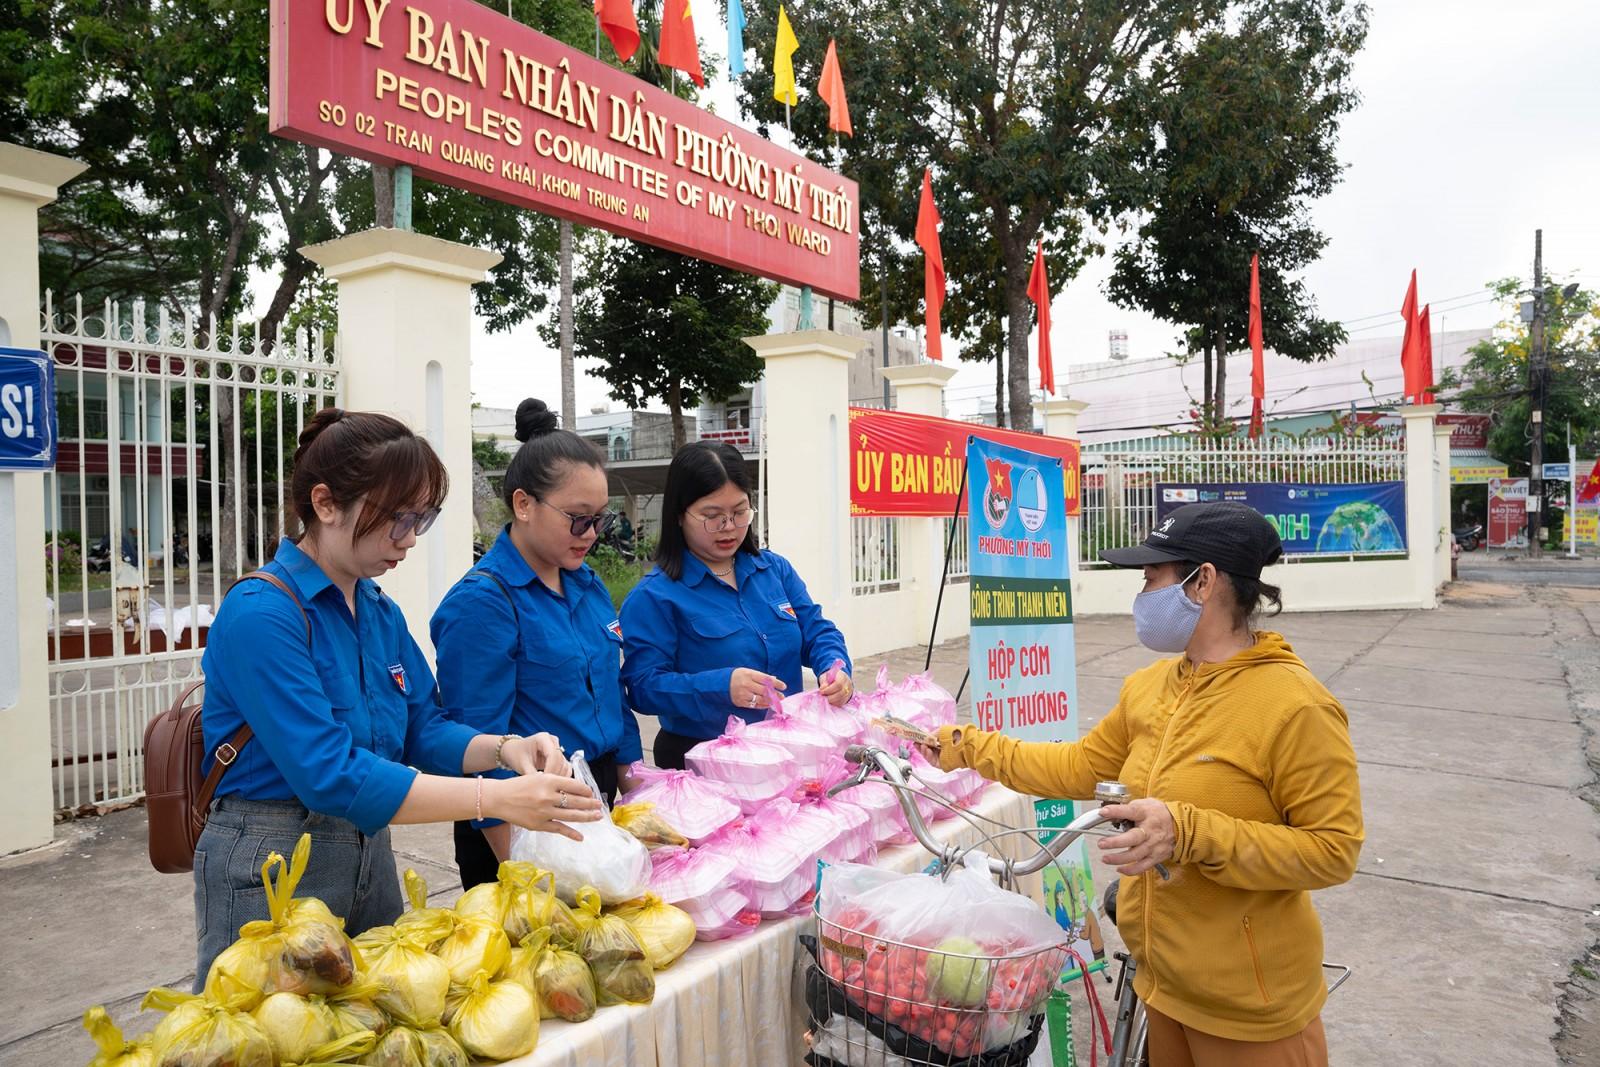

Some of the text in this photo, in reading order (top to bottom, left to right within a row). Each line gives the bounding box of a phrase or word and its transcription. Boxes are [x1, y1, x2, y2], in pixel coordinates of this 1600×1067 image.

[405, 6, 490, 88] BAN
[502, 48, 600, 132] NHÂN
[608, 90, 668, 159] DÂN
[674, 131, 769, 200] PHƯỜNG
[809, 185, 853, 234] THỚI
[319, 100, 347, 127] SO
[355, 111, 376, 137] 02
[384, 121, 433, 155] TRAN
[440, 140, 495, 174] QUANG
[542, 172, 581, 201] KHOM
[586, 187, 628, 216] TRUNG
[632, 204, 649, 223] AN
[376, 68, 831, 256] PEOPLE'S COMMITTEE OF MY THOI WARD
[1, 383, 34, 438] S!
[857, 433, 962, 495] ỦY BAN BẦU
[971, 584, 1067, 618] CÔNG TRÌNH THANH NIÊN
[988, 640, 1050, 689] HỘP CƠM
[976, 690, 1068, 733] YÊU THƯƠNG
[1050, 804, 1066, 818] Sáu
